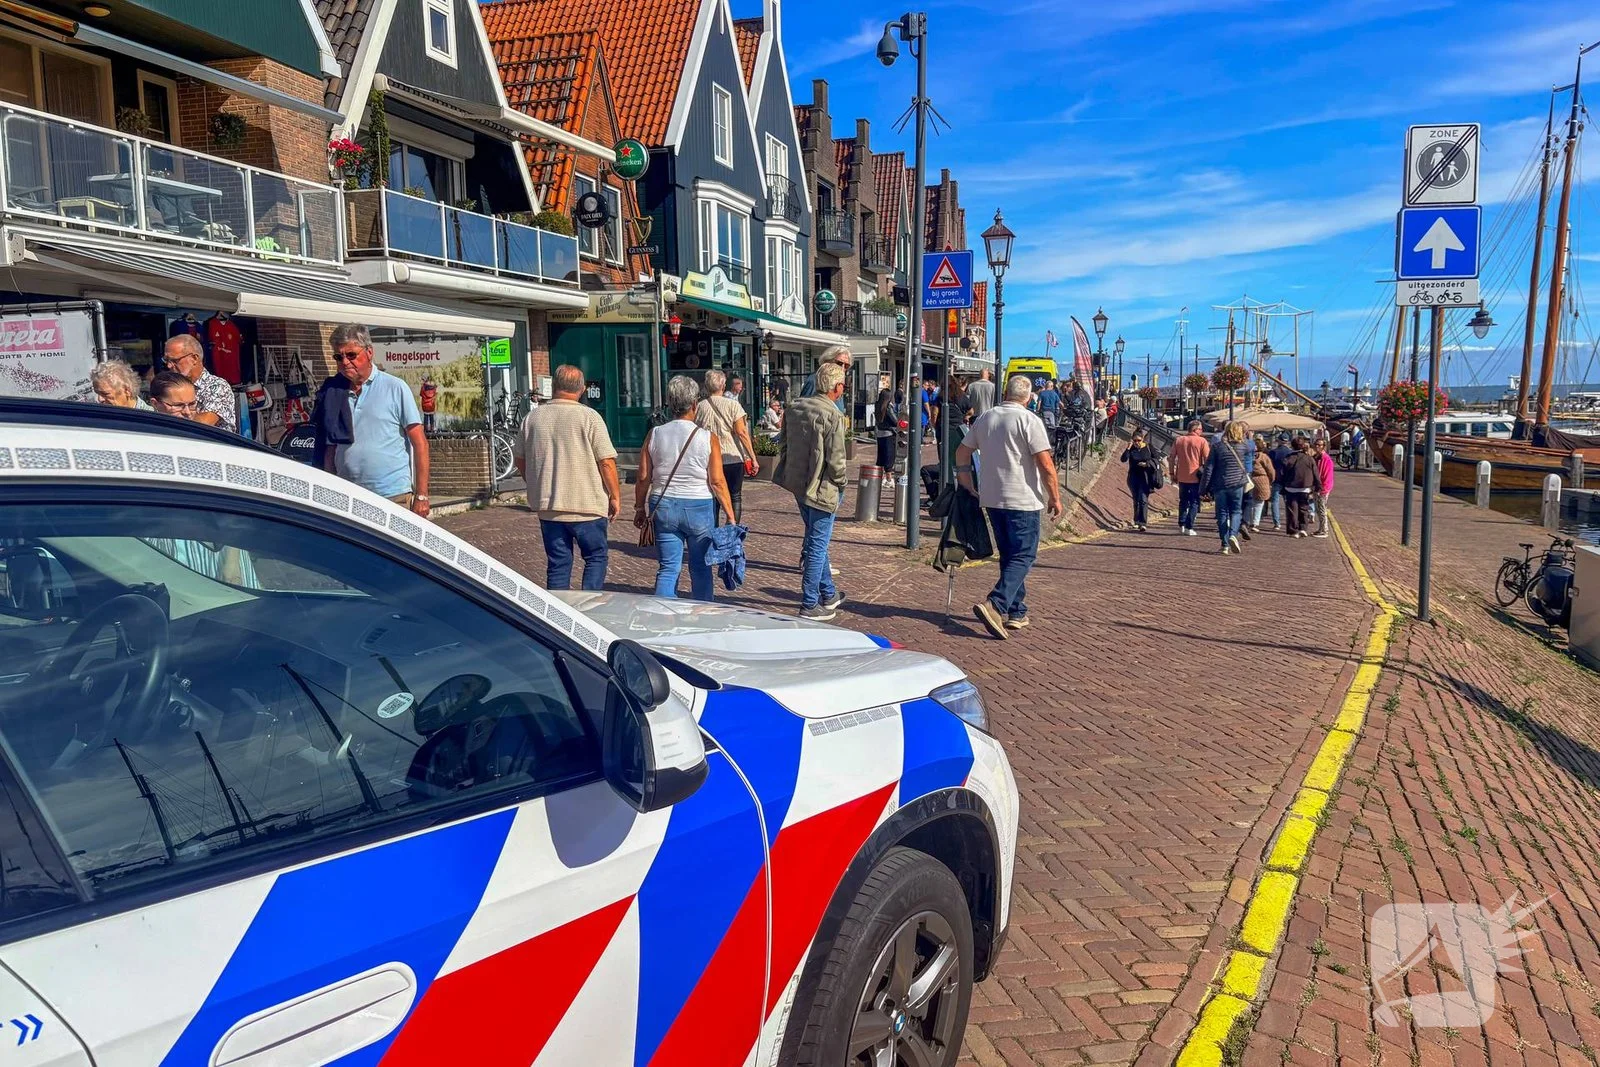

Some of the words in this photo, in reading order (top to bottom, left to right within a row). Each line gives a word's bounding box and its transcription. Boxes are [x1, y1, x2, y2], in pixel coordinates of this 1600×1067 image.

[1429, 129, 1459, 138] ZONE
[1408, 280, 1465, 291] uitgezonderd
[385, 350, 441, 365] Hengelsport
[586, 387, 601, 399] 166
